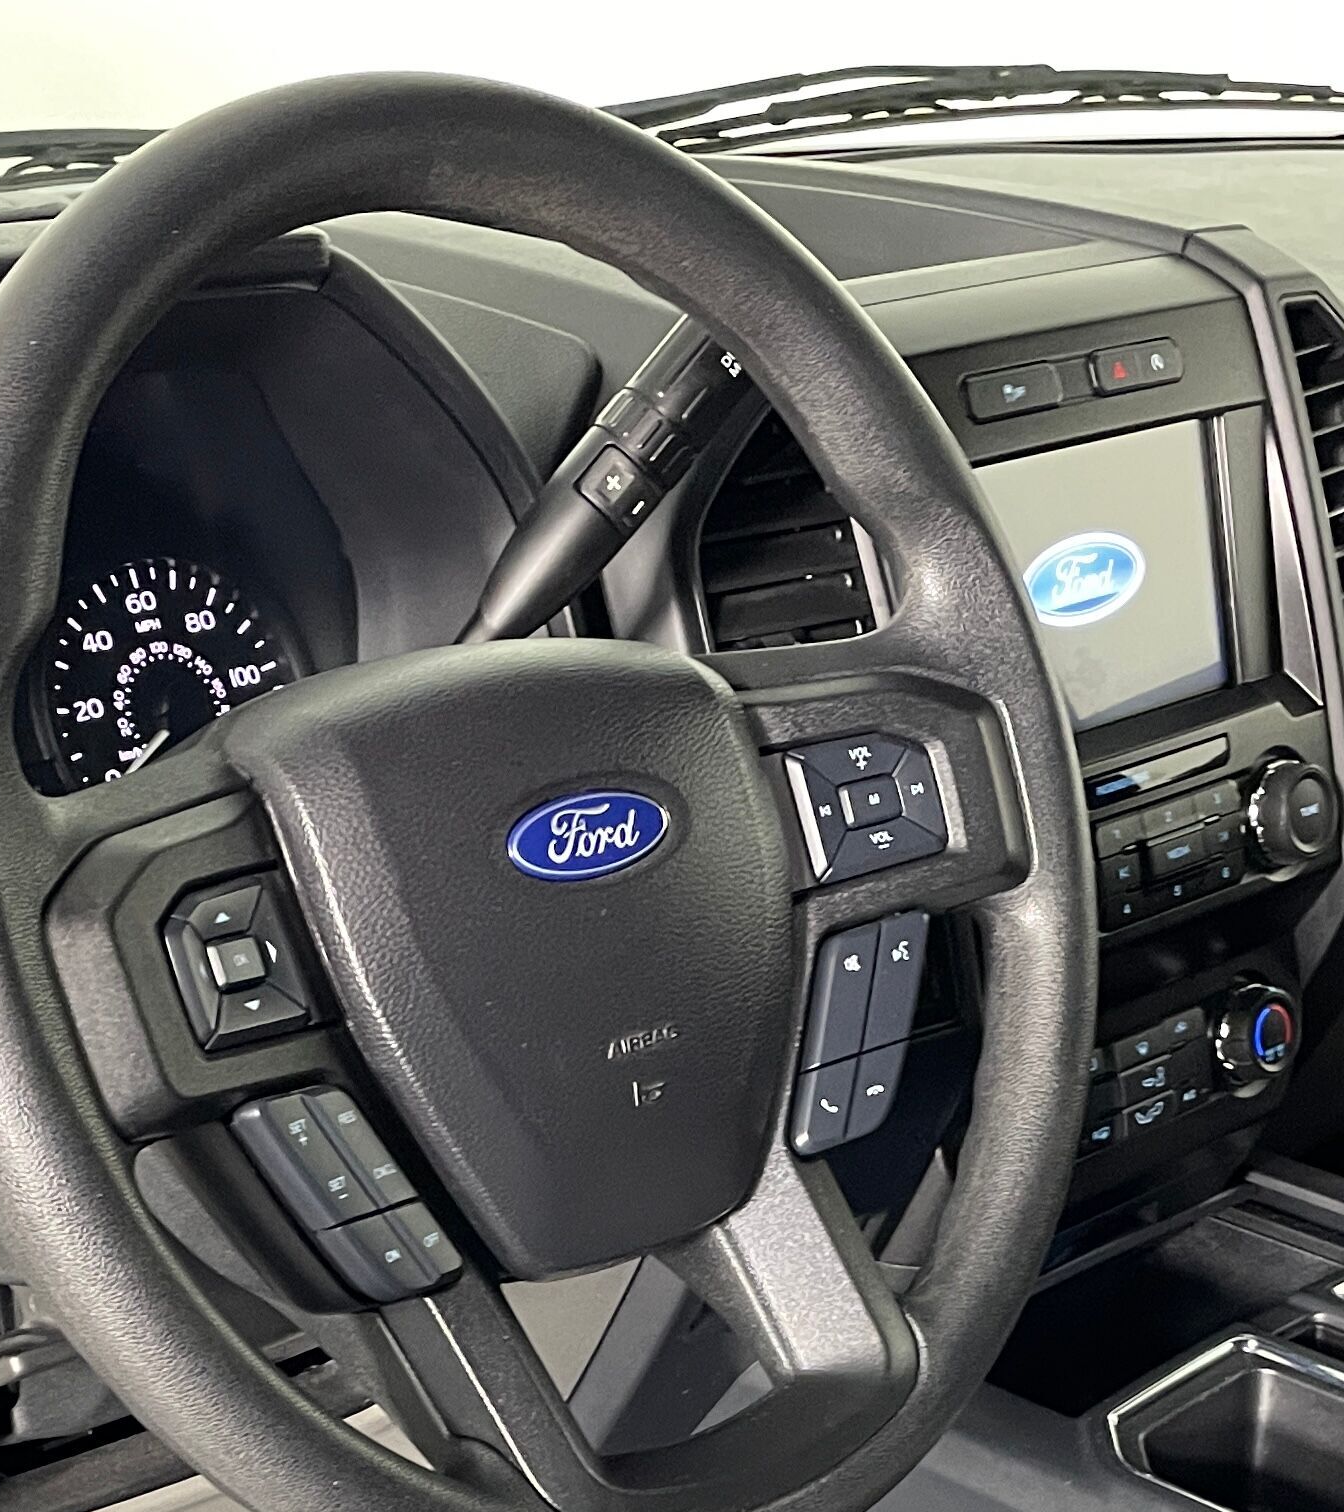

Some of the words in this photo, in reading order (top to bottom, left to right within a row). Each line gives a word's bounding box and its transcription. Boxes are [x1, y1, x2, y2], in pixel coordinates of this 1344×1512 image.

[125, 591, 156, 614] 60
[135, 618, 162, 633] MPH
[184, 610, 216, 633] 80
[82, 631, 113, 652] 40
[228, 665, 261, 688] 100
[72, 698, 104, 722] 20
[547, 803, 641, 864] Ford
